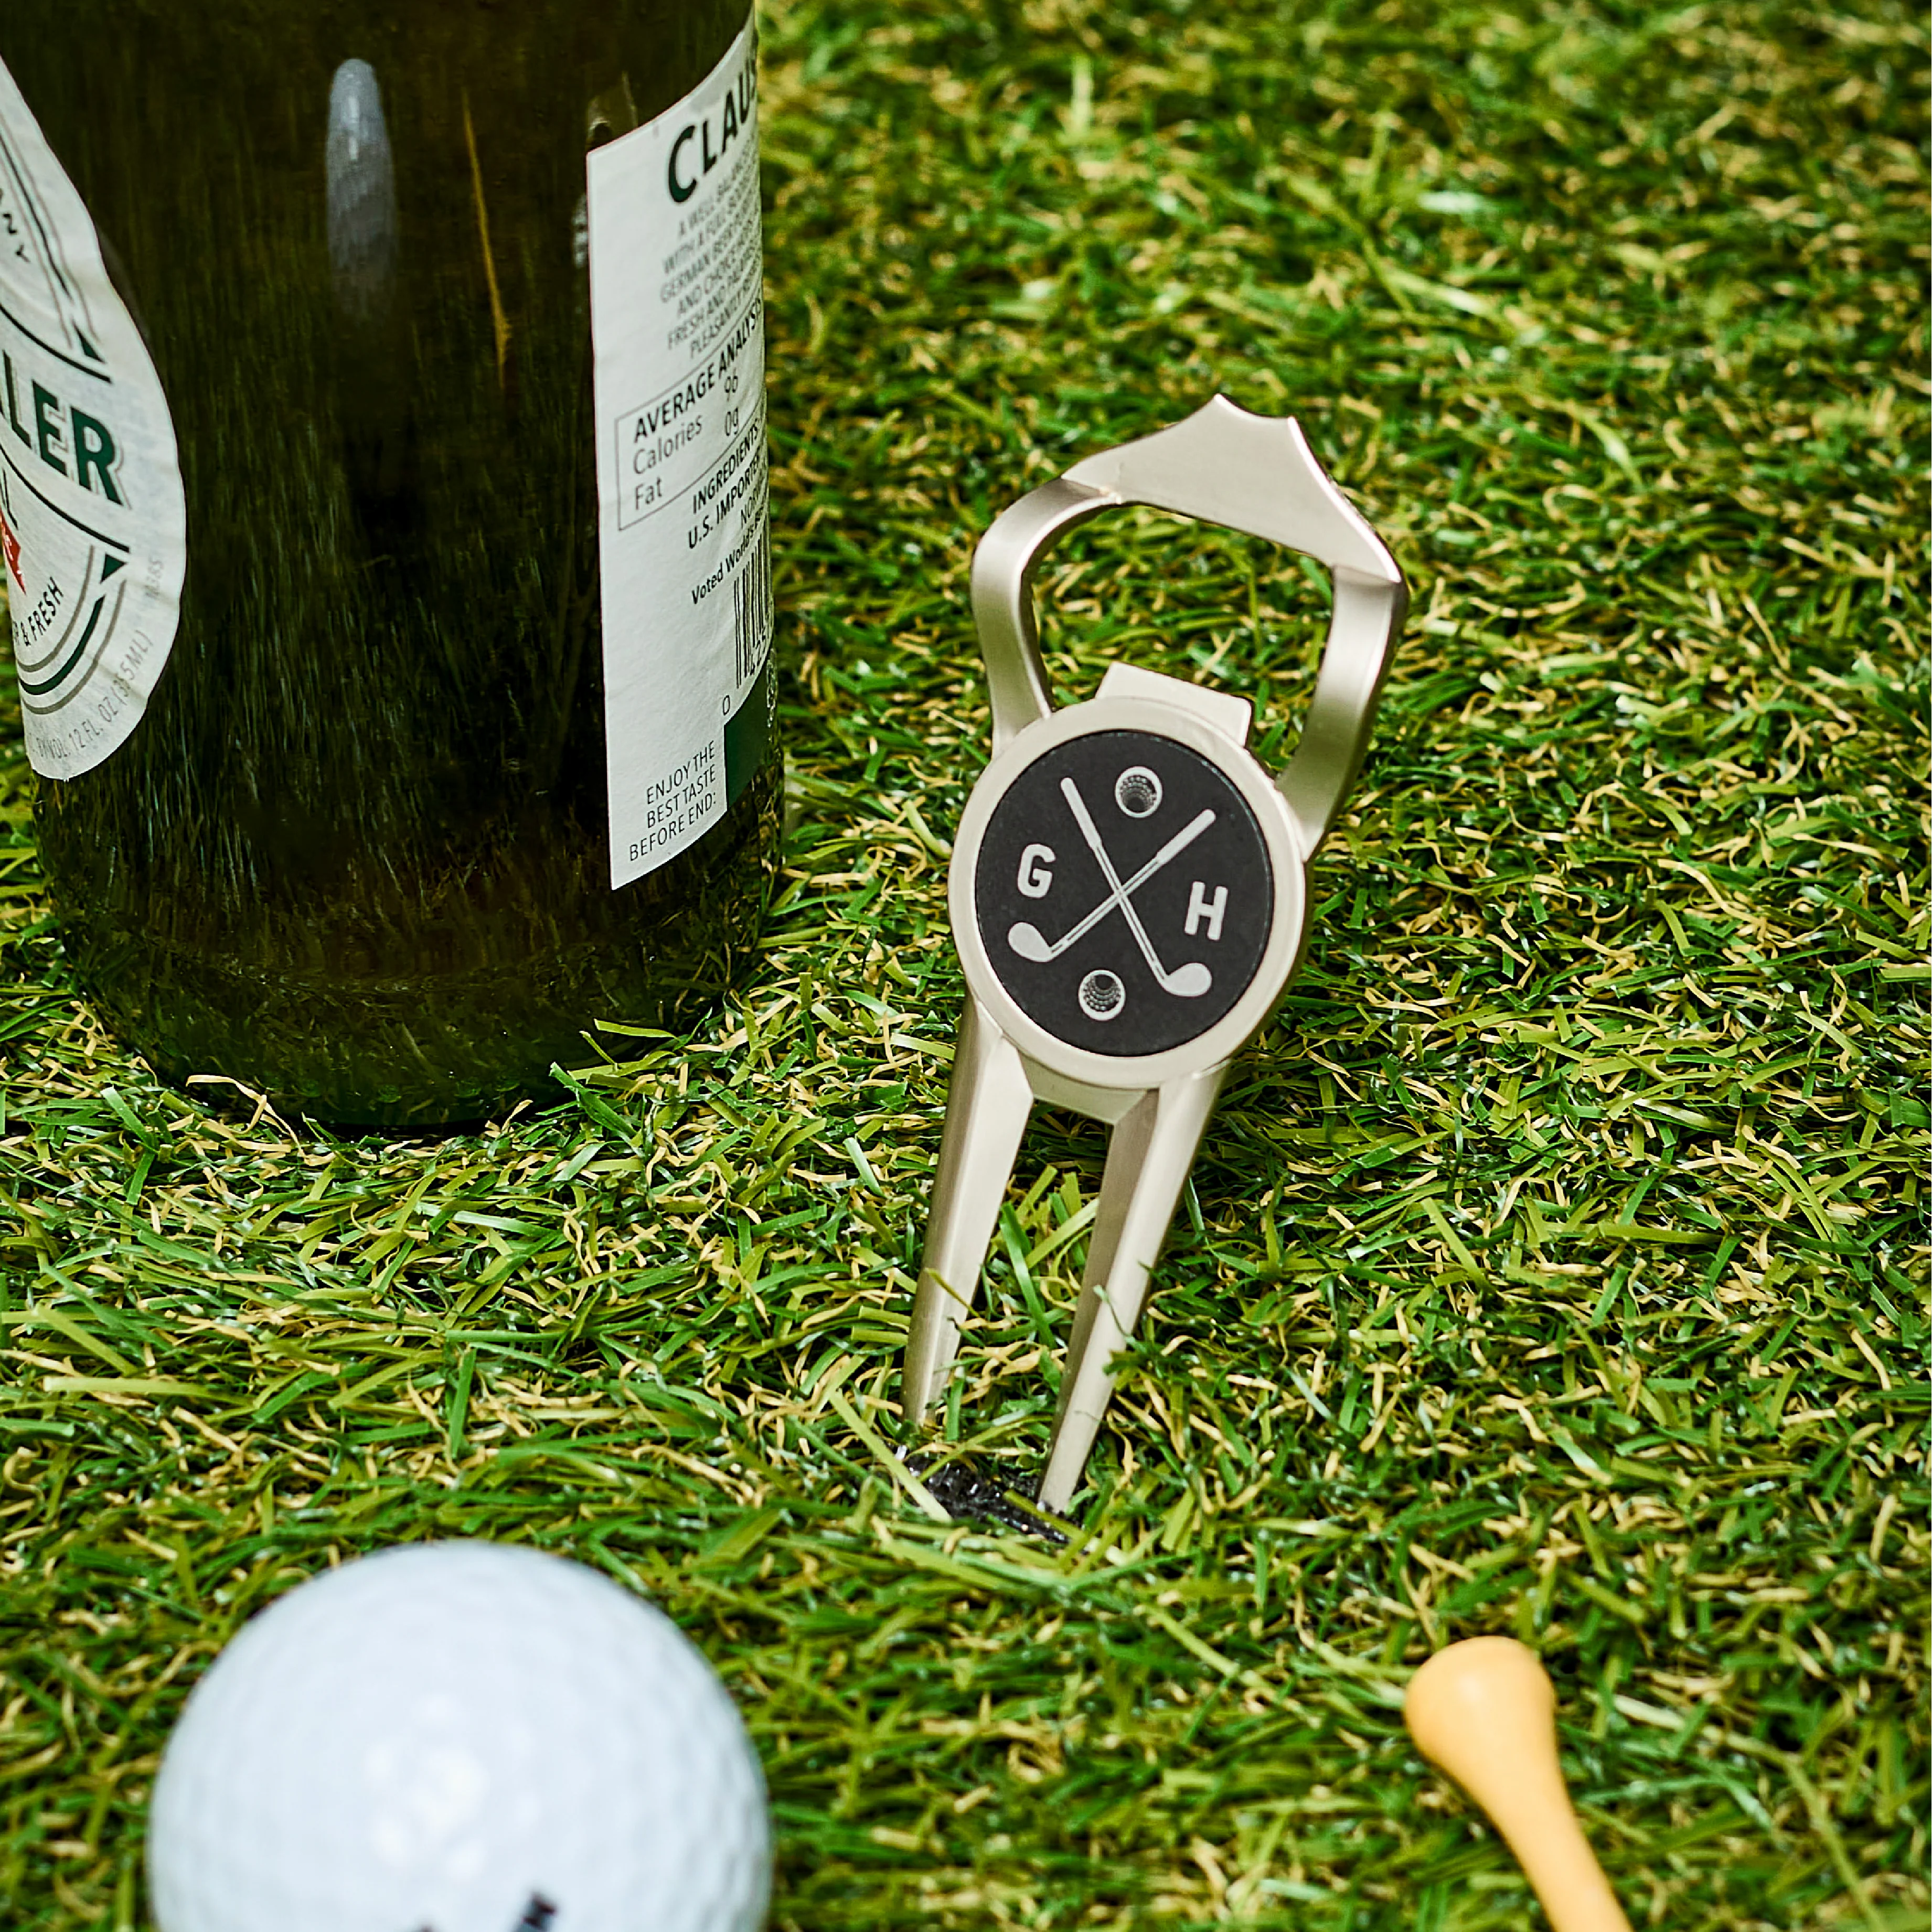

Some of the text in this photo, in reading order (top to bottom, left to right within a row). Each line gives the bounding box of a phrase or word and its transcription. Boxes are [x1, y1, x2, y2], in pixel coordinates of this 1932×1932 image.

[667, 306, 705, 351] FRESH
[677, 283, 702, 319] AND
[634, 362, 714, 444] AVERAGE
[633, 415, 702, 475] Calories
[635, 407, 739, 510] Fat 0g
[688, 515, 713, 549] U.S.
[28, 576, 64, 643] FRESH
[691, 561, 723, 604] Voted
[98, 696, 119, 722] OZ
[646, 740, 715, 805] ENJOY THE
[647, 764, 716, 829] BEST TASTE
[630, 792, 716, 861] BEFORE END:
[1017, 843, 1056, 899] G
[1184, 881, 1229, 941] H
